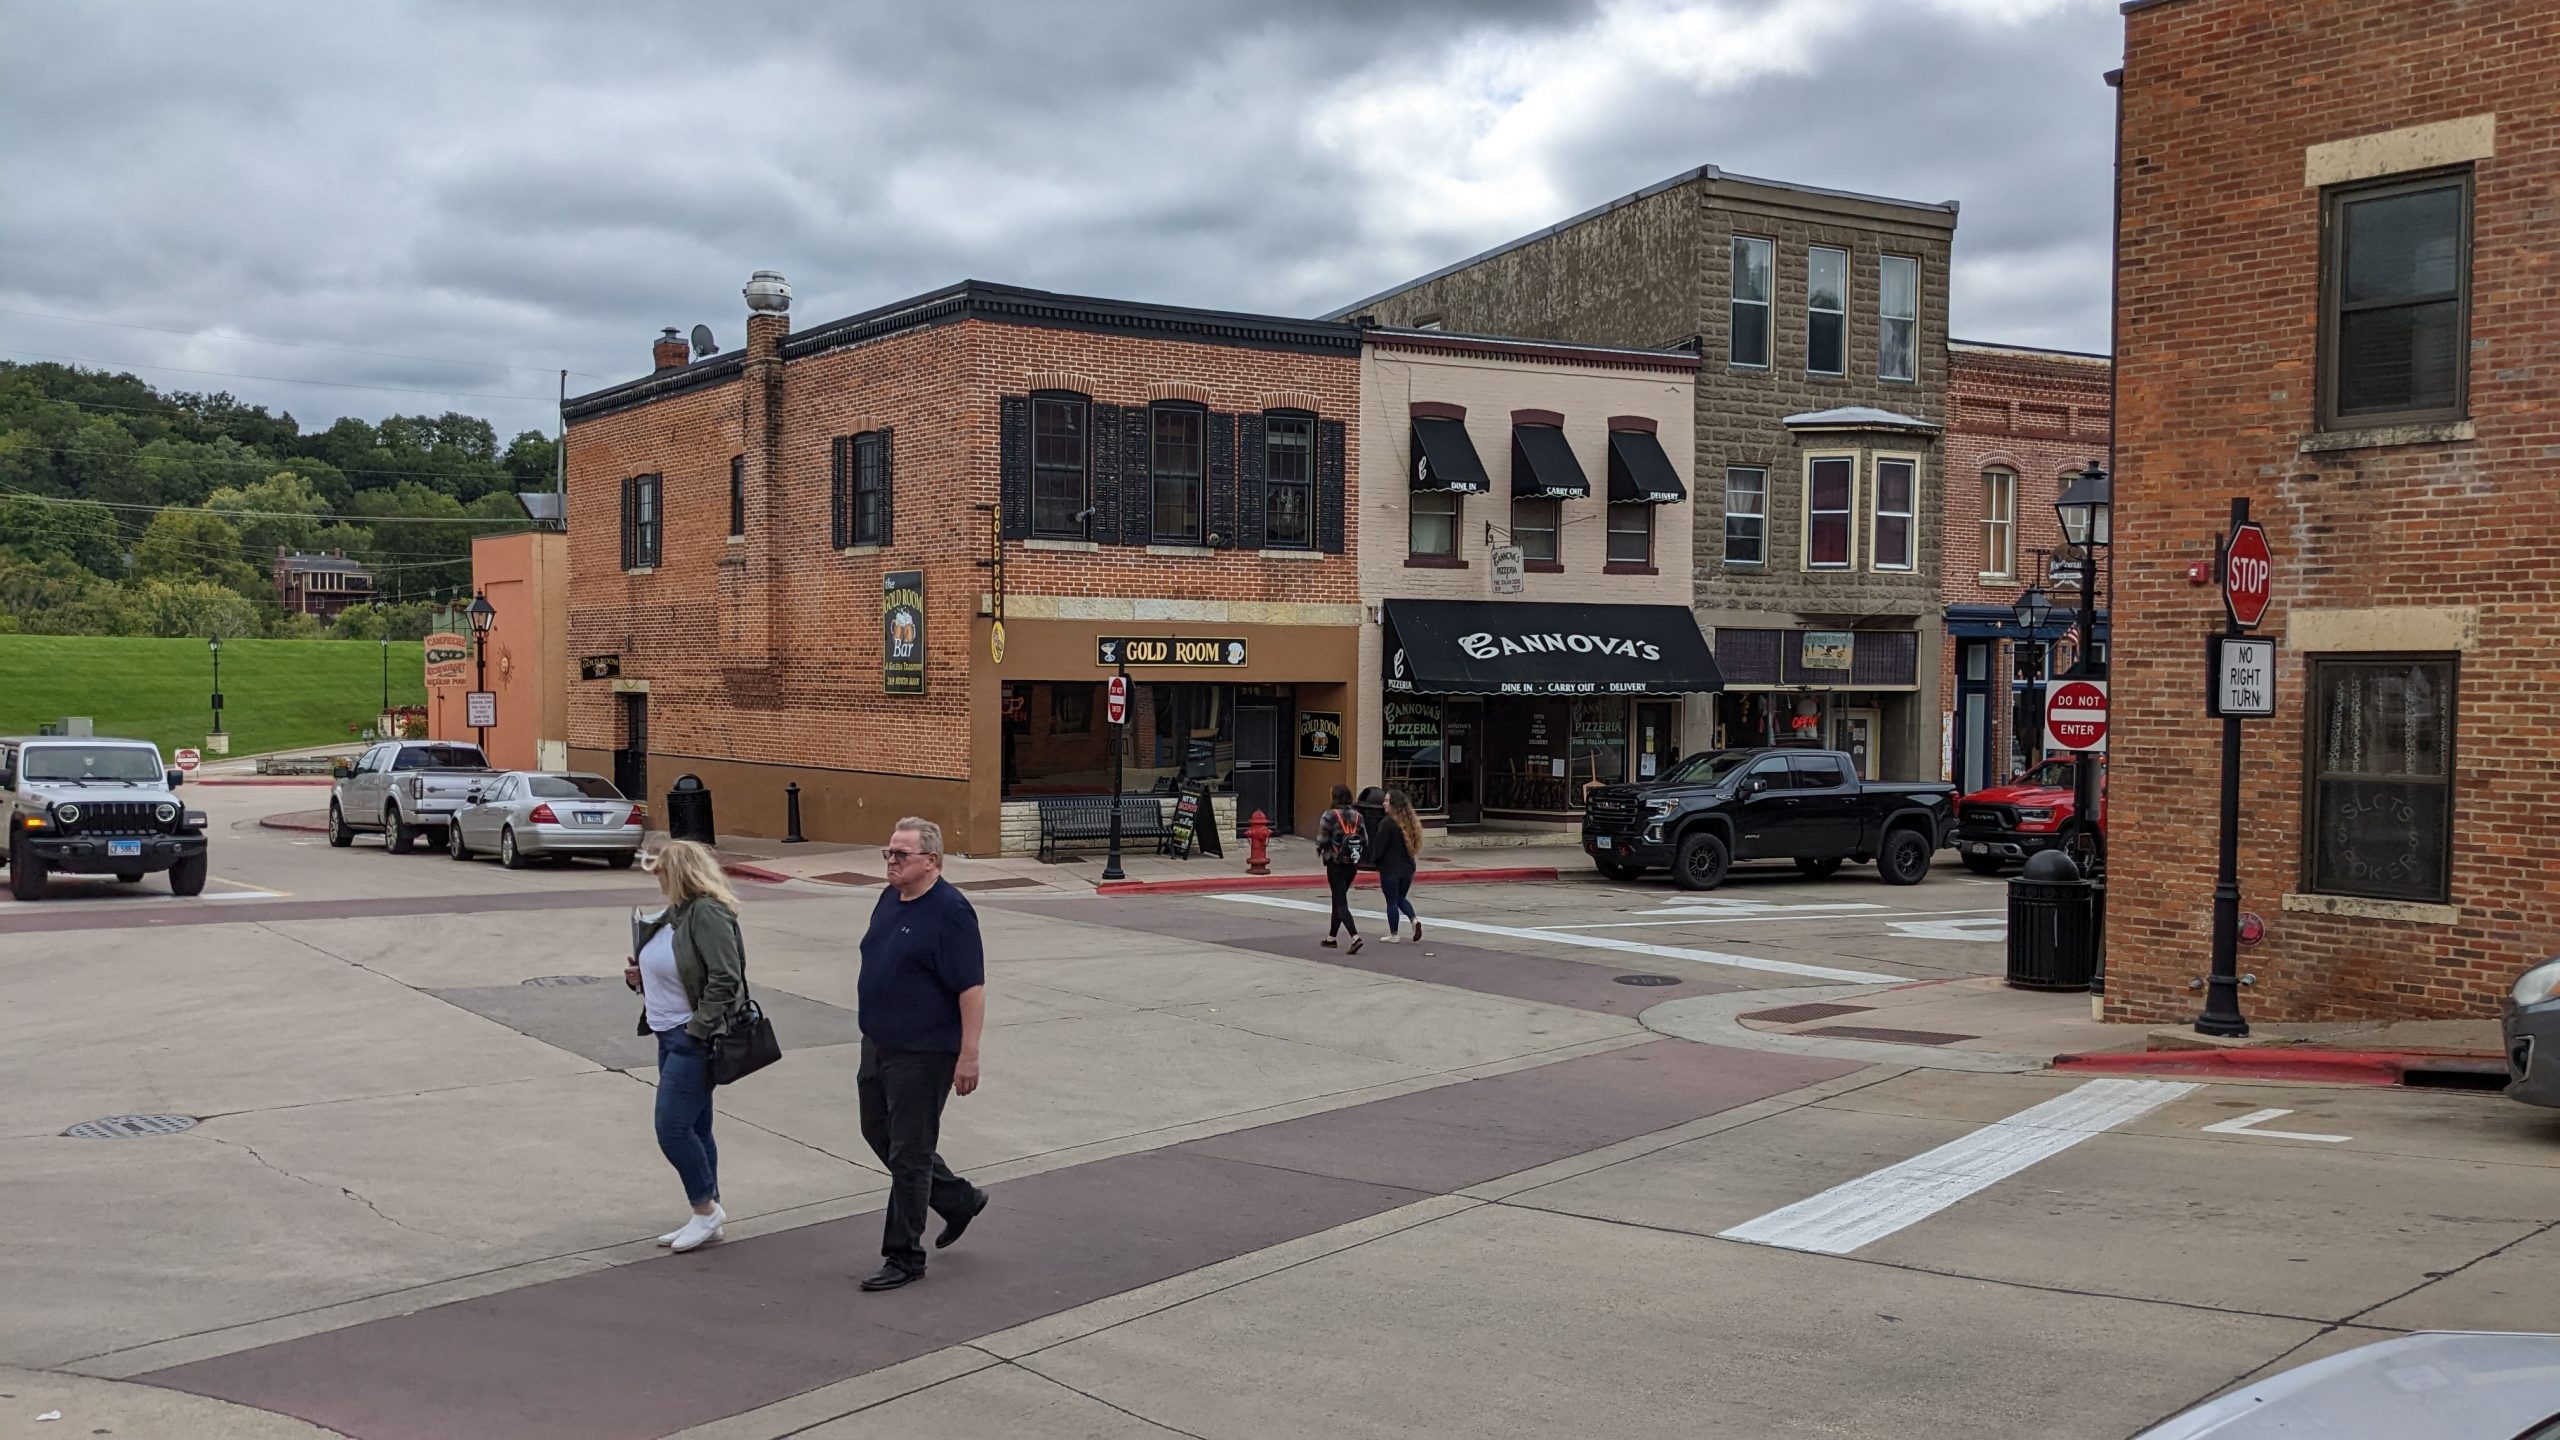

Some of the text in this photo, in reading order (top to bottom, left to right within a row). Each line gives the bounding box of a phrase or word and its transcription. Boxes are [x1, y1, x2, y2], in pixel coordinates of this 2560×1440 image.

[1451, 482, 1477, 490] DINE IN
[1547, 487, 1584, 496] CARRY OUT
[1650, 492, 1679, 500] DELIVERY
[1497, 566, 1518, 575] PIZZERIA
[2230, 556, 2269, 594] STOP
[885, 577, 895, 589] the
[884, 588, 923, 613] GOLD ROOM
[893, 638, 914, 658] Bar
[1126, 641, 1220, 664] GOLD ROOM
[1457, 632, 1661, 661] CANNOVA'S
[2238, 646, 2253, 664] NO
[2230, 668, 2261, 686] RIGHT
[1111, 686, 1117, 694] DO
[1388, 679, 1413, 690] PIZZERIA
[1501, 682, 1647, 692] DINE IN CARRY OUT DELIVERY
[2058, 695, 2101, 707] DO NOT
[2231, 690, 2261, 708] TURN
[1112, 705, 1122, 713] ENTER
[1384, 702, 1441, 723] CANNOVA'S
[1575, 721, 1622, 732] PIZZERIA
[1792, 715, 1817, 728] OPEN
[1301, 719, 1340, 738] GOLD ROOM
[1388, 723, 1438, 735] PIZZERIA
[2061, 724, 2095, 735] ENTER
[1312, 743, 1327, 753] Bar
[1383, 739, 1441, 747] FINE ITALIAN CUISINE
